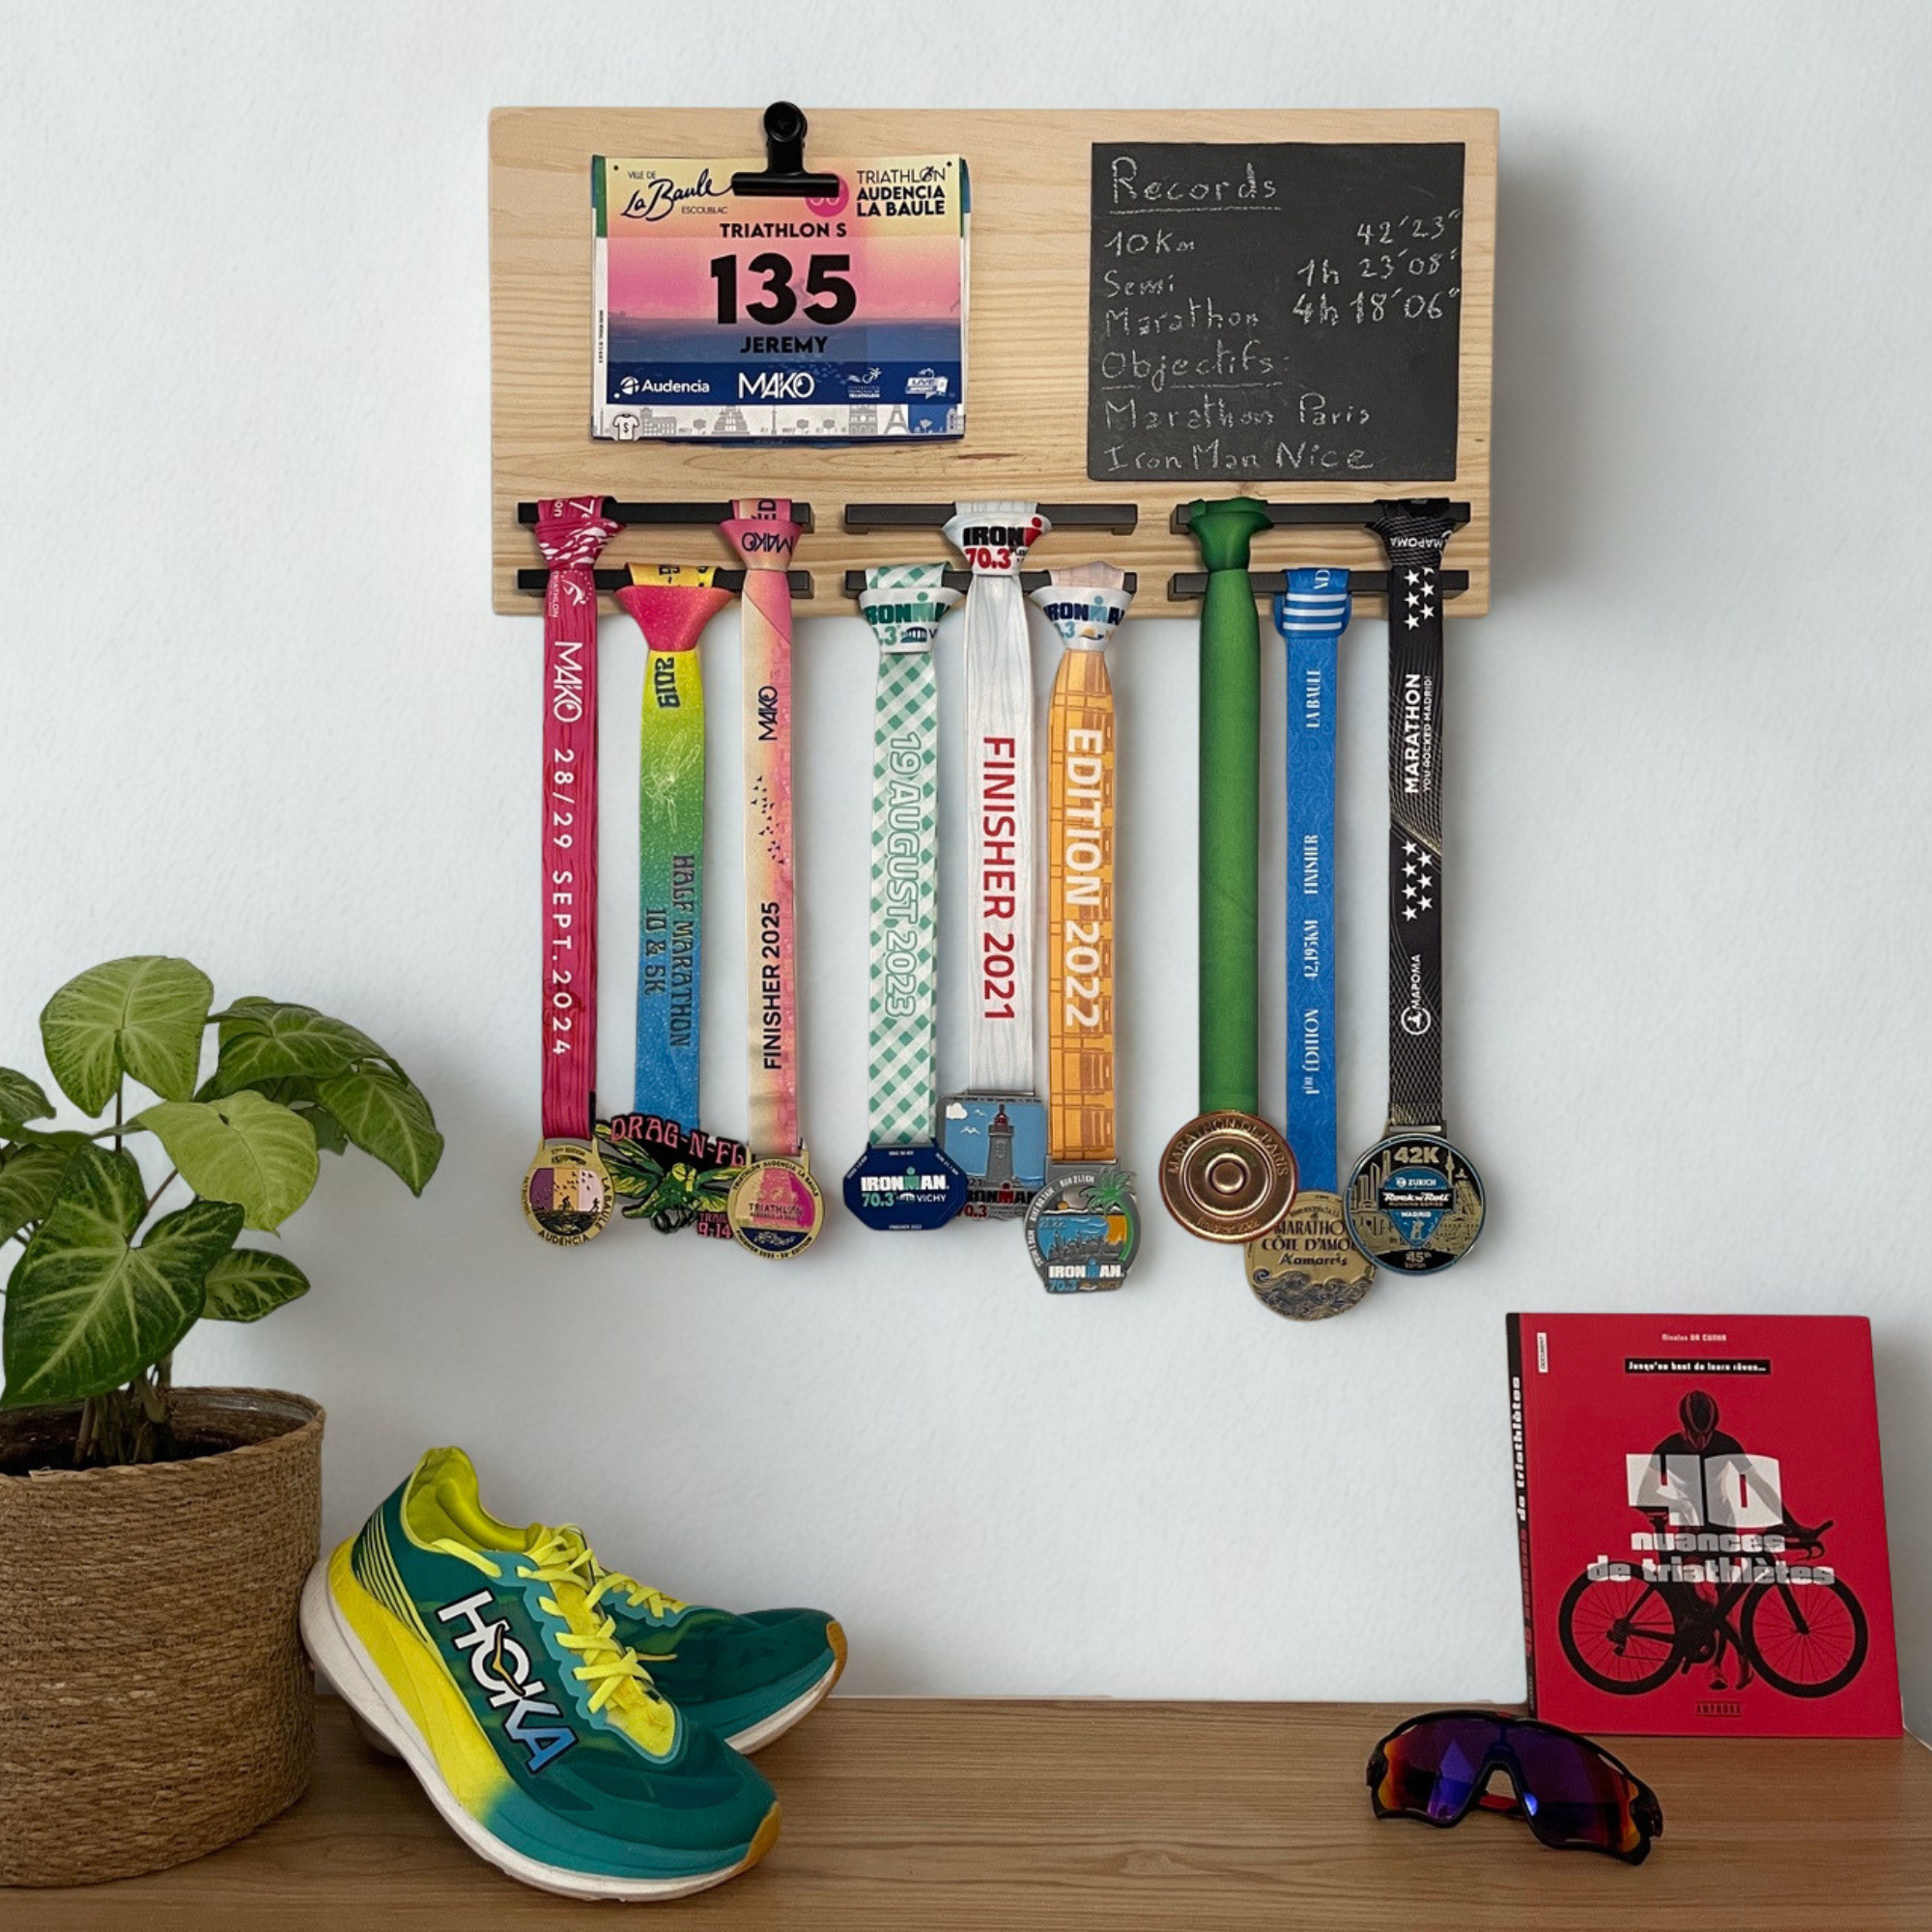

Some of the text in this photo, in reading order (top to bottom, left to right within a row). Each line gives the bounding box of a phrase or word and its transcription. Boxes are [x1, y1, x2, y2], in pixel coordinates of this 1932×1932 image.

[628, 171, 657, 180] VILLE DE
[856, 166, 946, 185] TRIATHLON
[1111, 156, 1277, 204] Records
[856, 185, 946, 201] AUDENCIA
[856, 202, 881, 217] LA
[886, 200, 946, 216] BAULE
[719, 222, 847, 239] TRIATHLON S
[710, 252, 857, 326] 135
[1104, 270, 1176, 298] Semi
[1105, 298, 1260, 337] Marathon
[740, 335, 829, 355] JEREMY
[641, 379, 710, 393] Audencia
[738, 372, 815, 399] MAKO
[1105, 392, 1370, 430] Marathon Paris
[1275, 440, 1374, 469] Nice
[1390, 537, 1443, 549] MAPOMA
[964, 548, 1011, 570] 70.3
[554, 640, 582, 723] MAKO
[655, 657, 681, 708] 2019
[758, 686, 778, 740] MAKO
[1305, 669, 1321, 728] LA BAULE
[1405, 674, 1421, 793] MARATHON
[1422, 771, 1432, 792] YOU
[553, 748, 575, 849] 28/29
[885, 732, 922, 1017] 19 AUGUST 2023
[983, 736, 1014, 1019] FINISHER 2021
[1065, 727, 1103, 1028] EDITION 2022
[1303, 835, 1320, 895] FINISHER
[644, 908, 667, 996] 10 & 5K
[669, 855, 695, 1047] HALF MARATHON
[761, 901, 781, 1069] FINISHER 2025
[1410, 953, 1421, 1009] MAPOMA
[1394, 1147, 1440, 1164] 42K
[861, 1167, 948, 1192] IRONMAN
[862, 1192, 895, 1207] 70.3
[916, 1193, 947, 1203] VICHY
[538, 1230, 590, 1246] AUDENCIA
[1048, 1279, 1079, 1292] 70.3
[1626, 1453, 1783, 1528] 40
[1517, 1495, 1526, 1521] de
[1631, 1532, 1786, 1552] nuances
[1587, 1554, 1835, 1585] de triathlètes
[436, 1590, 578, 1775] HOKA
